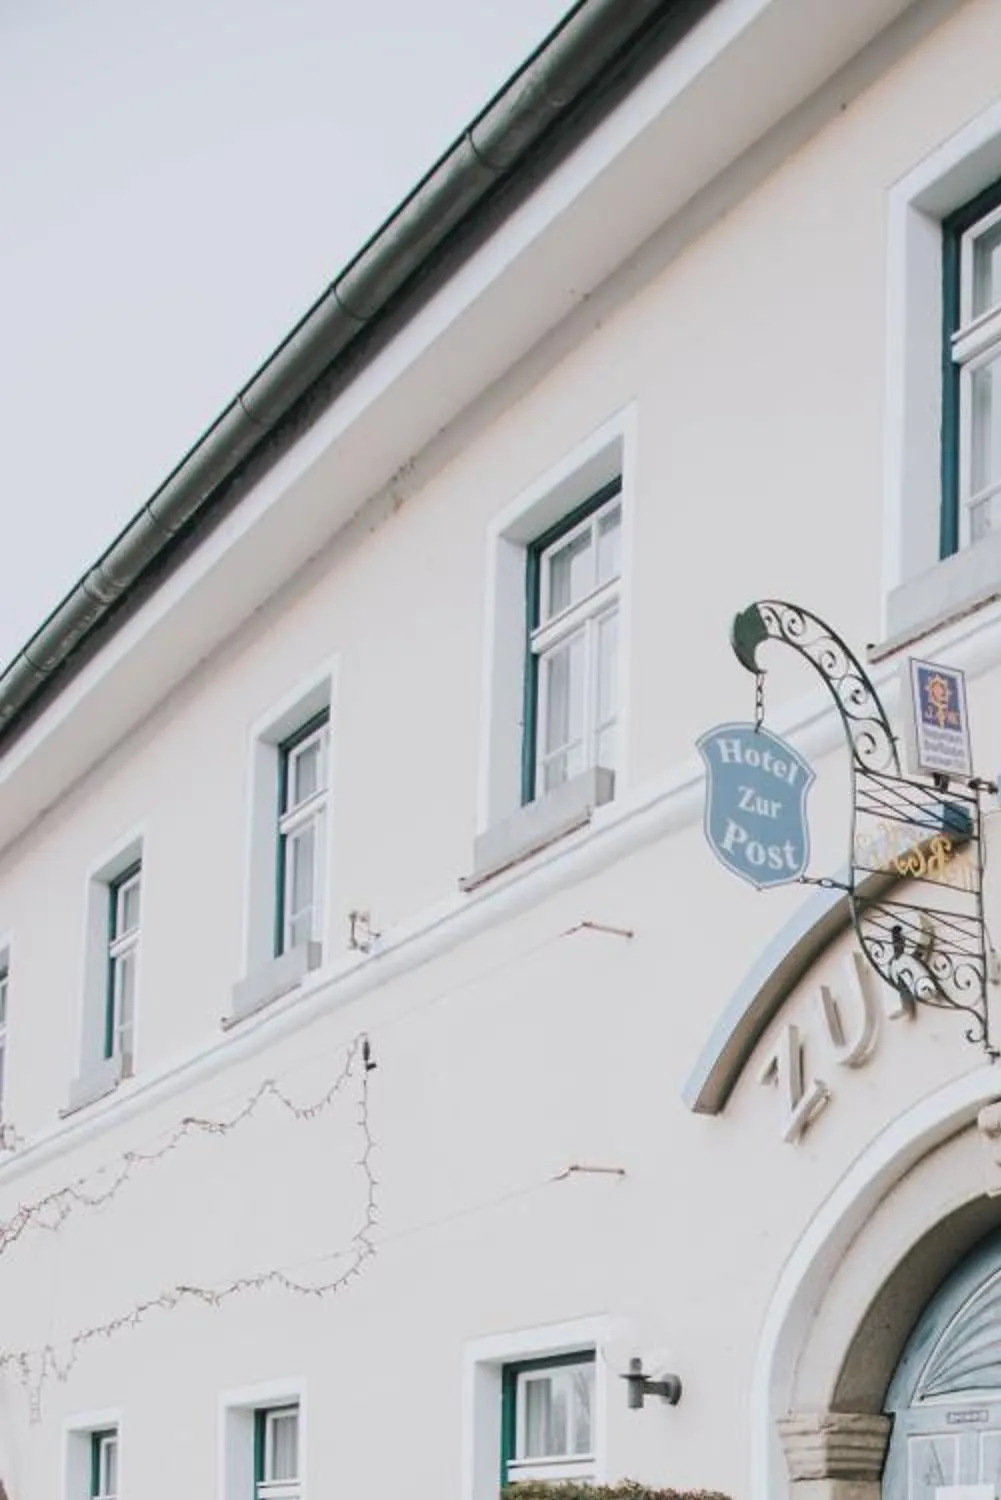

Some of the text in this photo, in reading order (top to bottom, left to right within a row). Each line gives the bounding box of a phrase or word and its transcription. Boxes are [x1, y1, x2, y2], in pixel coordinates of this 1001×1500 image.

[715, 737, 799, 787] Hotel
[737, 785, 783, 819] Zur
[720, 817, 799, 871] Post
